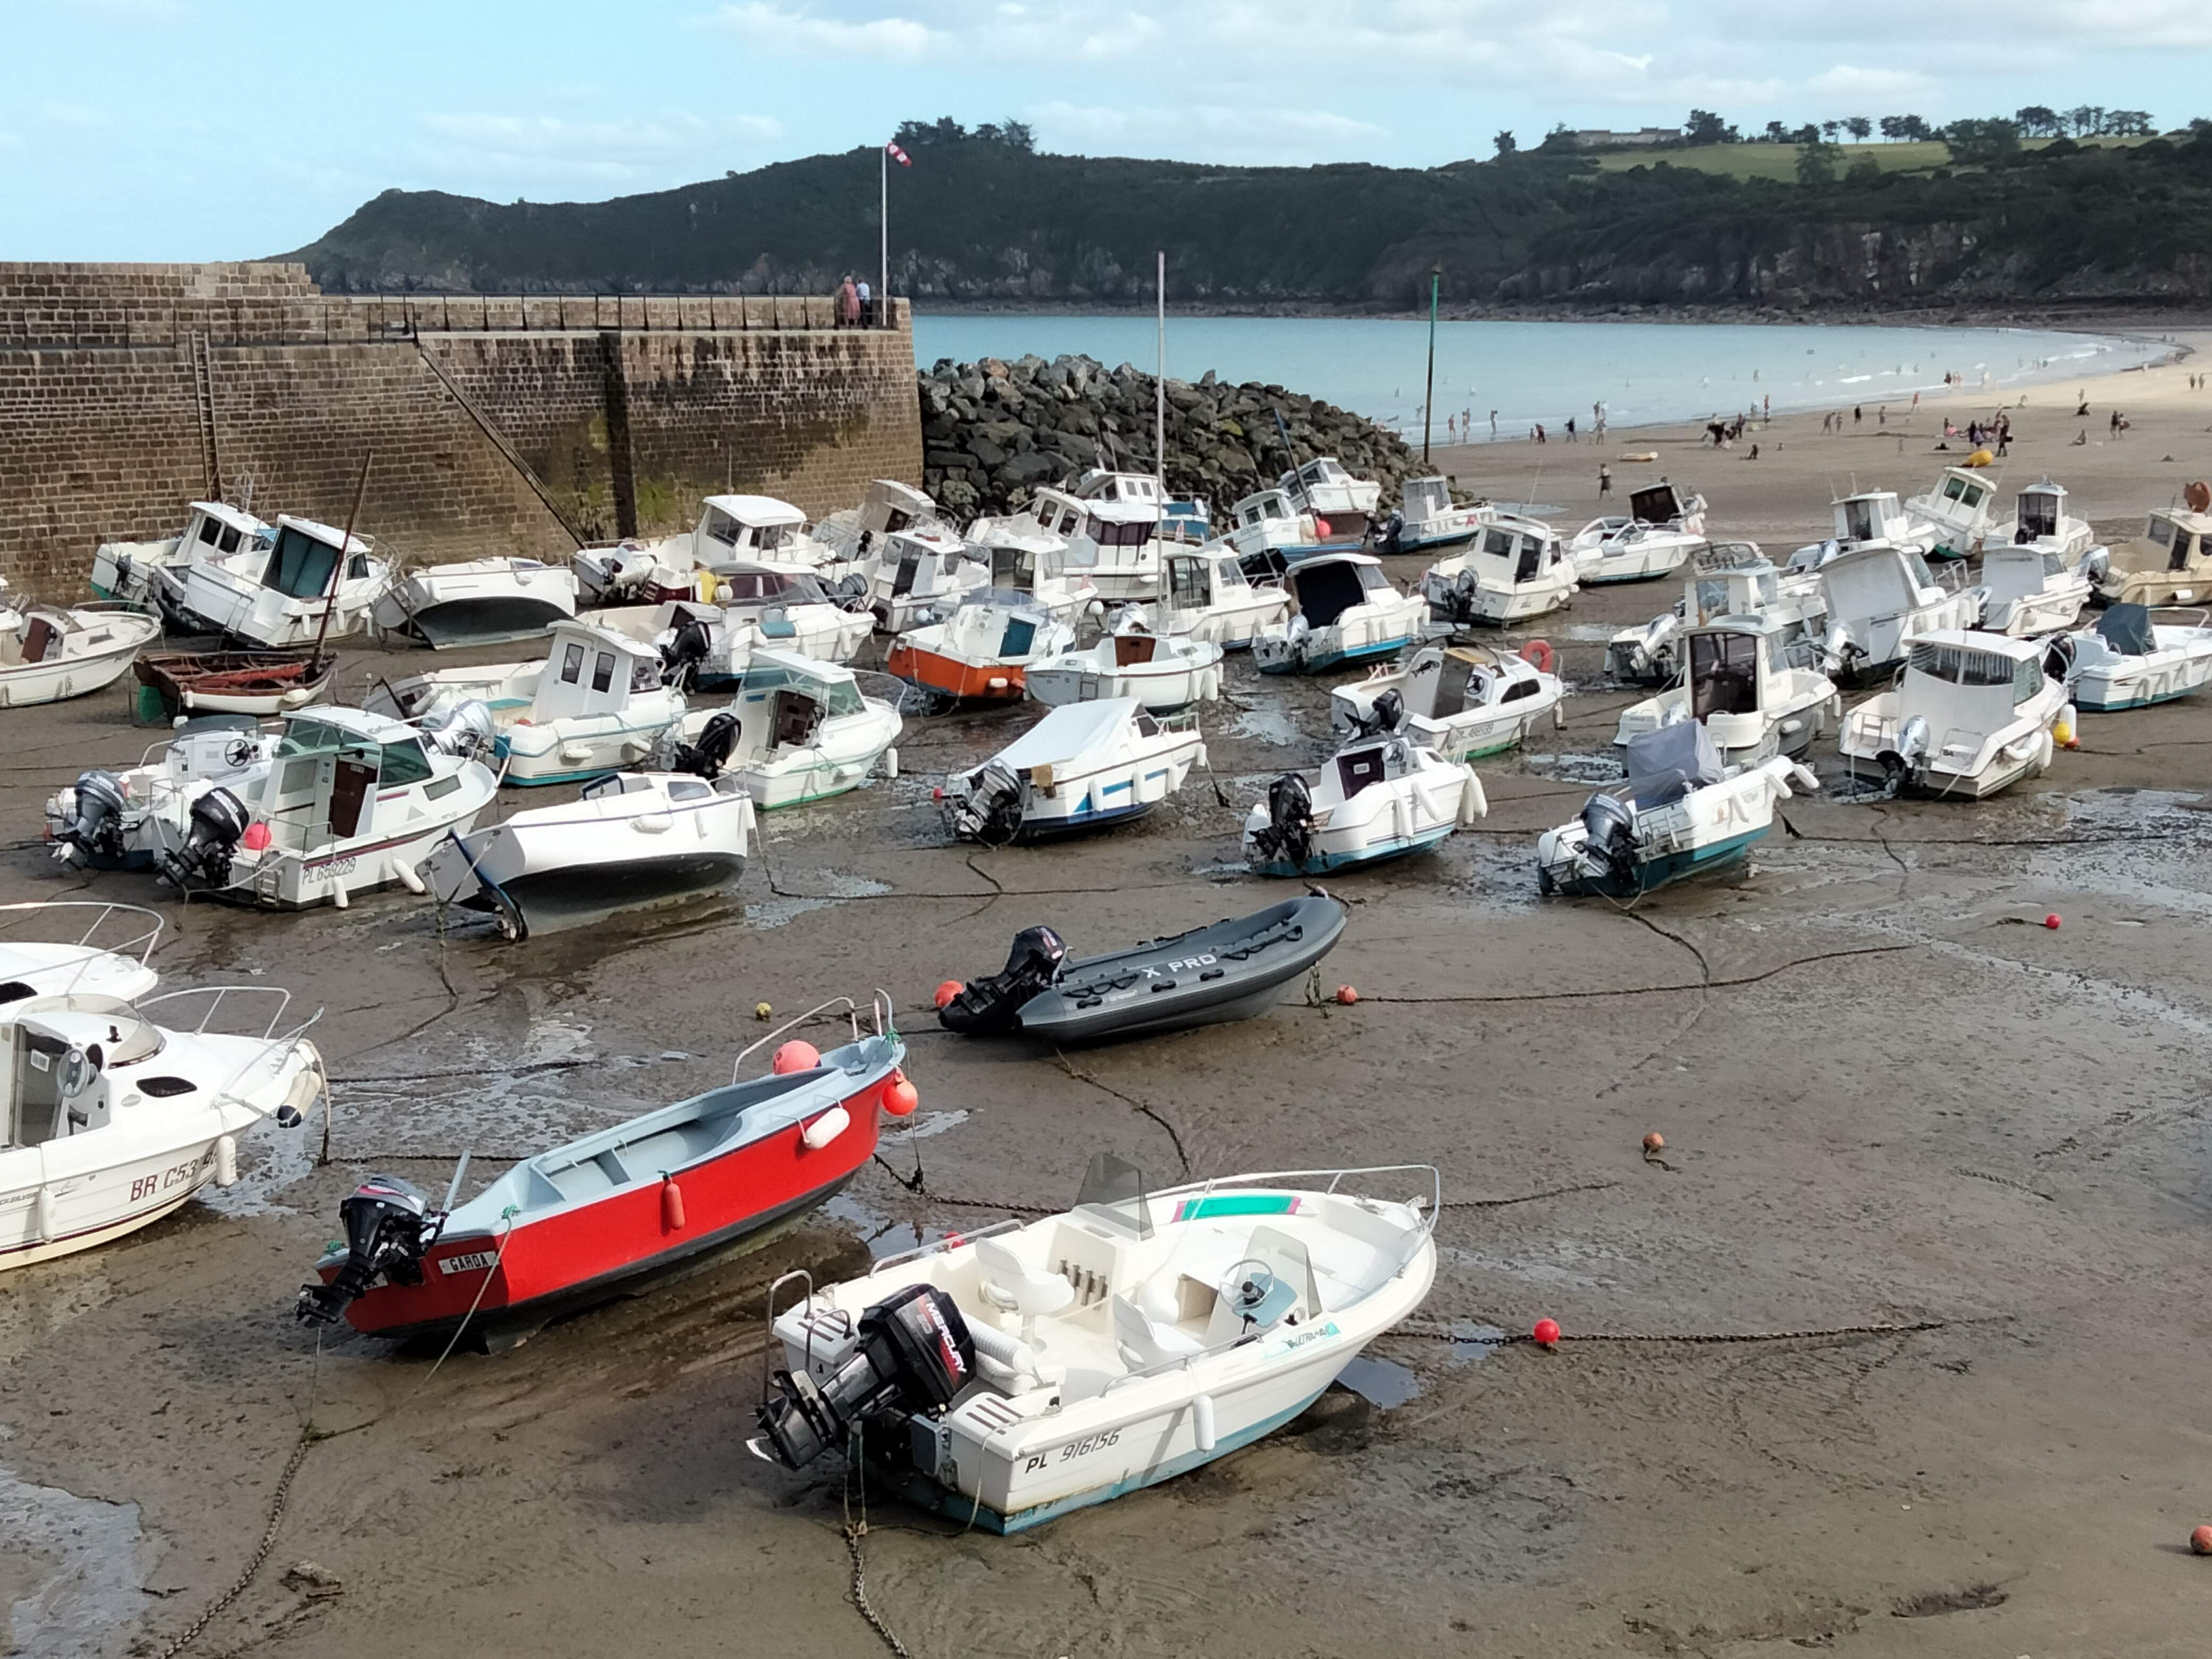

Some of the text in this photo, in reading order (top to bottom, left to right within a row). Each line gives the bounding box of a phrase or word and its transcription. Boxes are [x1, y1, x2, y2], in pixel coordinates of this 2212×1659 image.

[302, 857, 357, 885] PL 659229
[1141, 954, 1218, 979] X PRO
[130, 1174, 158, 1202] BR
[449, 1253, 489, 1271] GARDA
[925, 1302, 968, 1373] MERCURY
[1025, 1428, 1122, 1474] PL 916156
